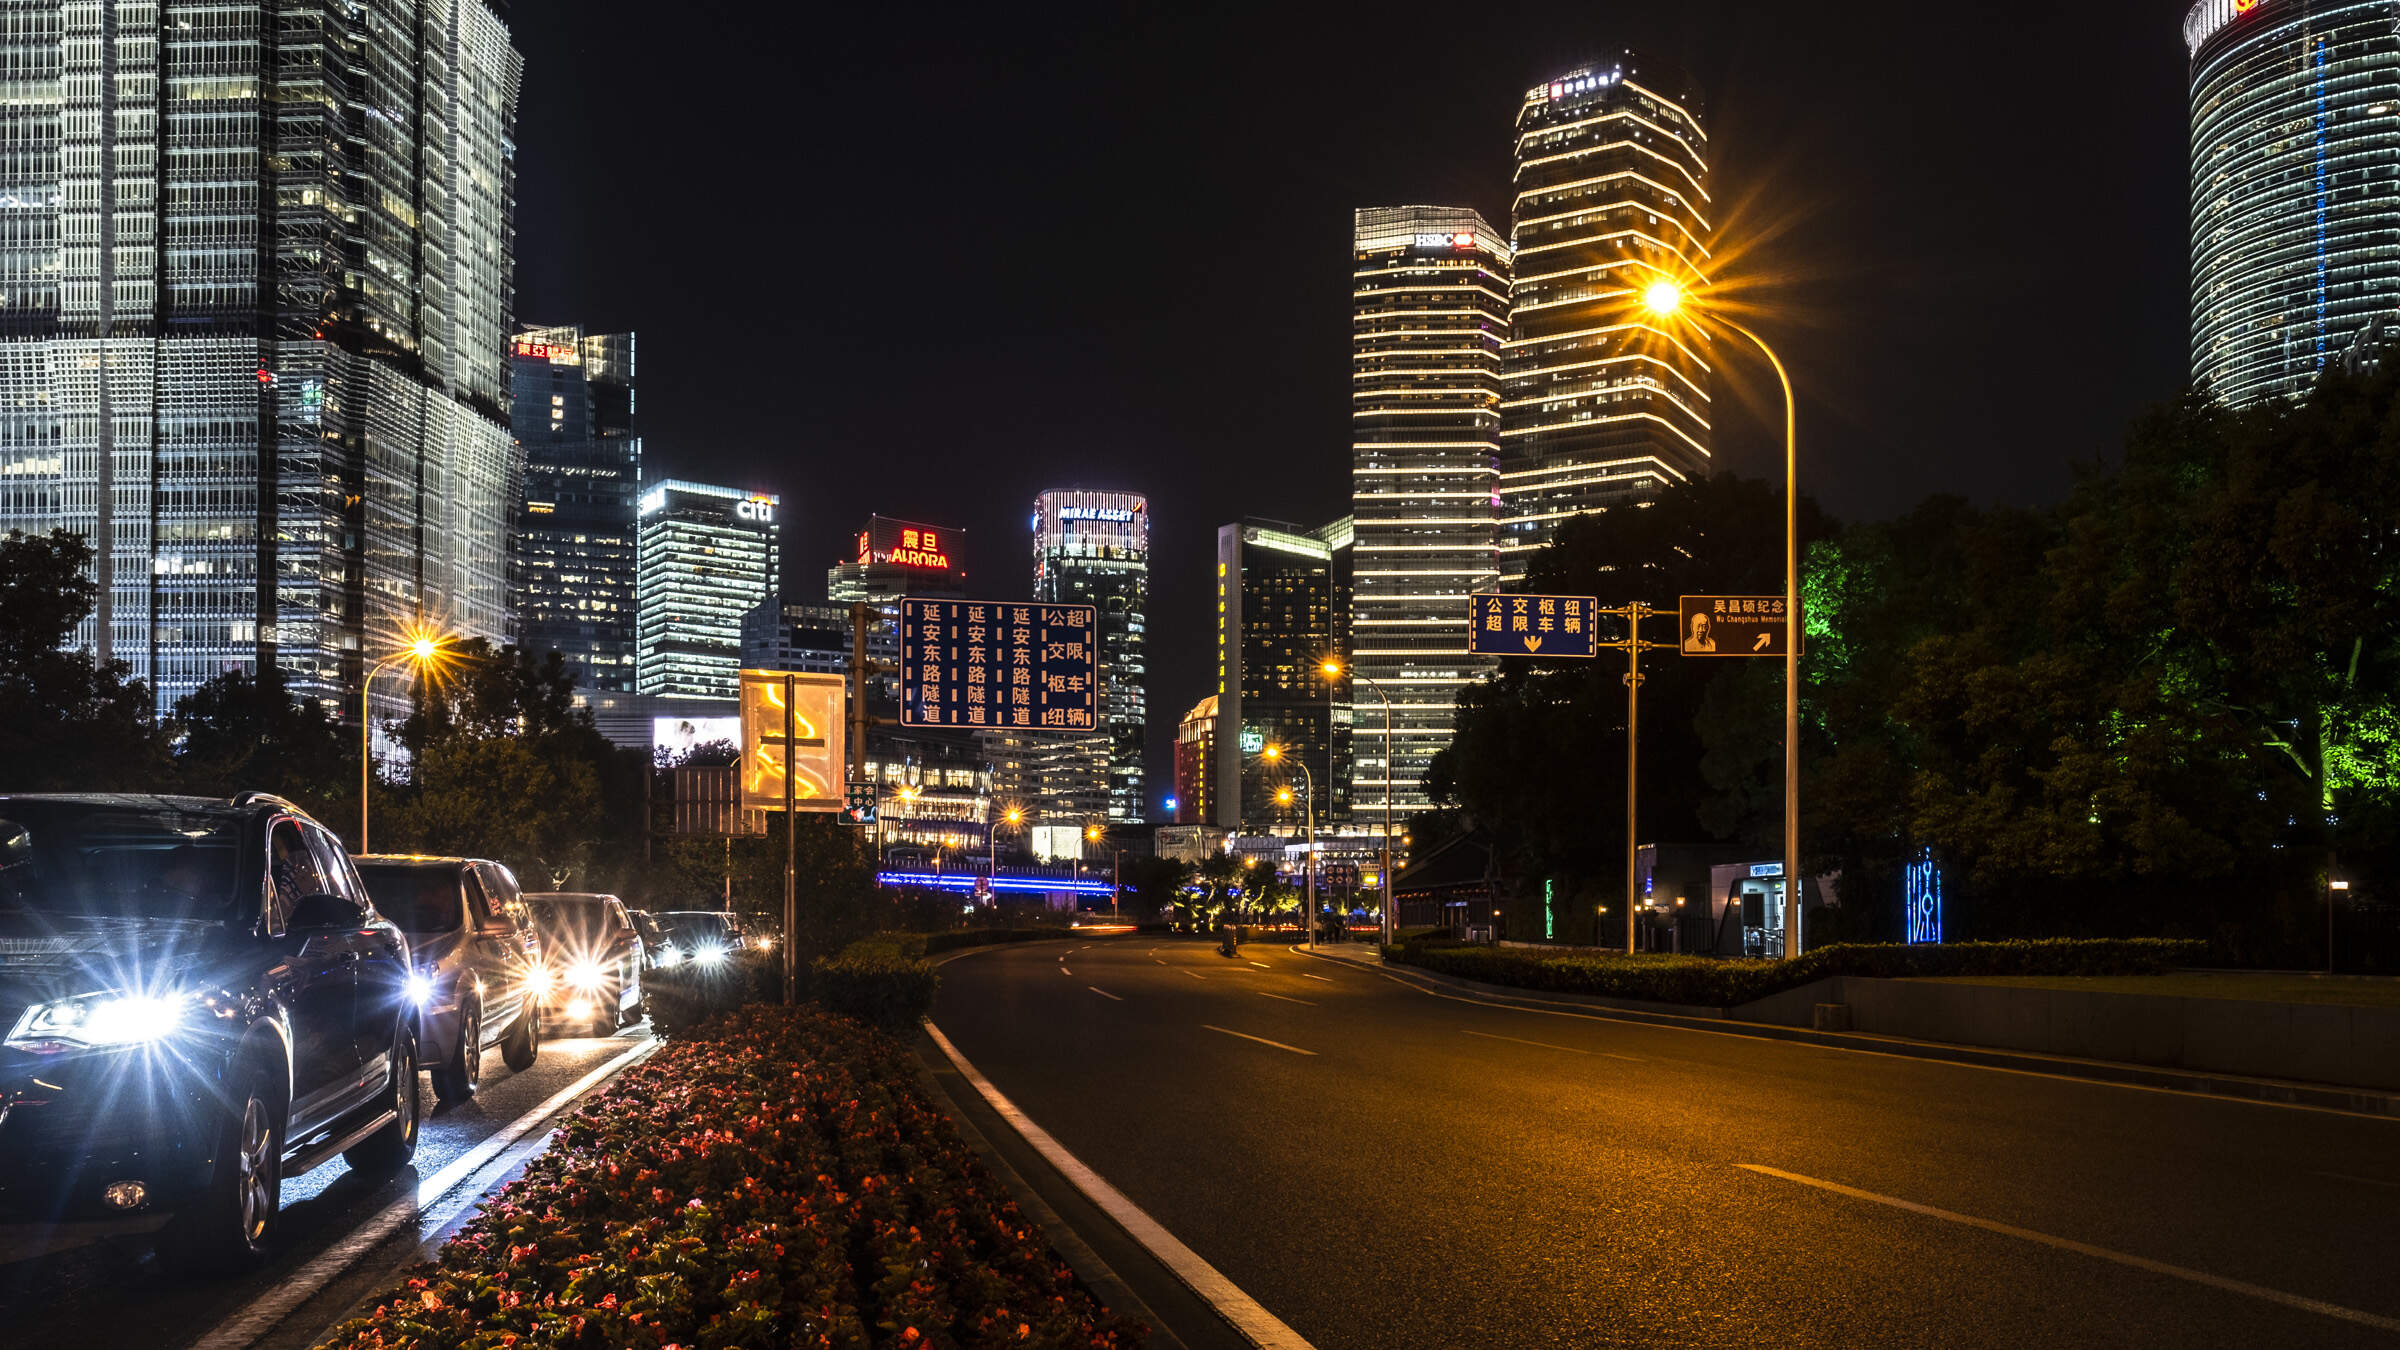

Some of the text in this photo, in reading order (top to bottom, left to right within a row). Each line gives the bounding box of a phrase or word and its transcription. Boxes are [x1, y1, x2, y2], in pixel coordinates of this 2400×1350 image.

[736, 498, 772, 521] citi
[1059, 507, 1133, 521] MIRAE ASSET
[903, 529, 938, 552] 震旦
[891, 547, 948, 568] AURORA
[1486, 598, 1580, 616] 公交枢纽
[1714, 599, 1789, 613] 吴昌硕纪念
[1486, 615, 1581, 634] 超限车辆
[922, 604, 941, 723] 延安东路隧道
[968, 606, 986, 724] 延安东路隧道
[1012, 608, 1031, 725] 延安东路隧道
[1048, 610, 1065, 726] 公交枢纽
[1066, 610, 1085, 726] 超限车辆
